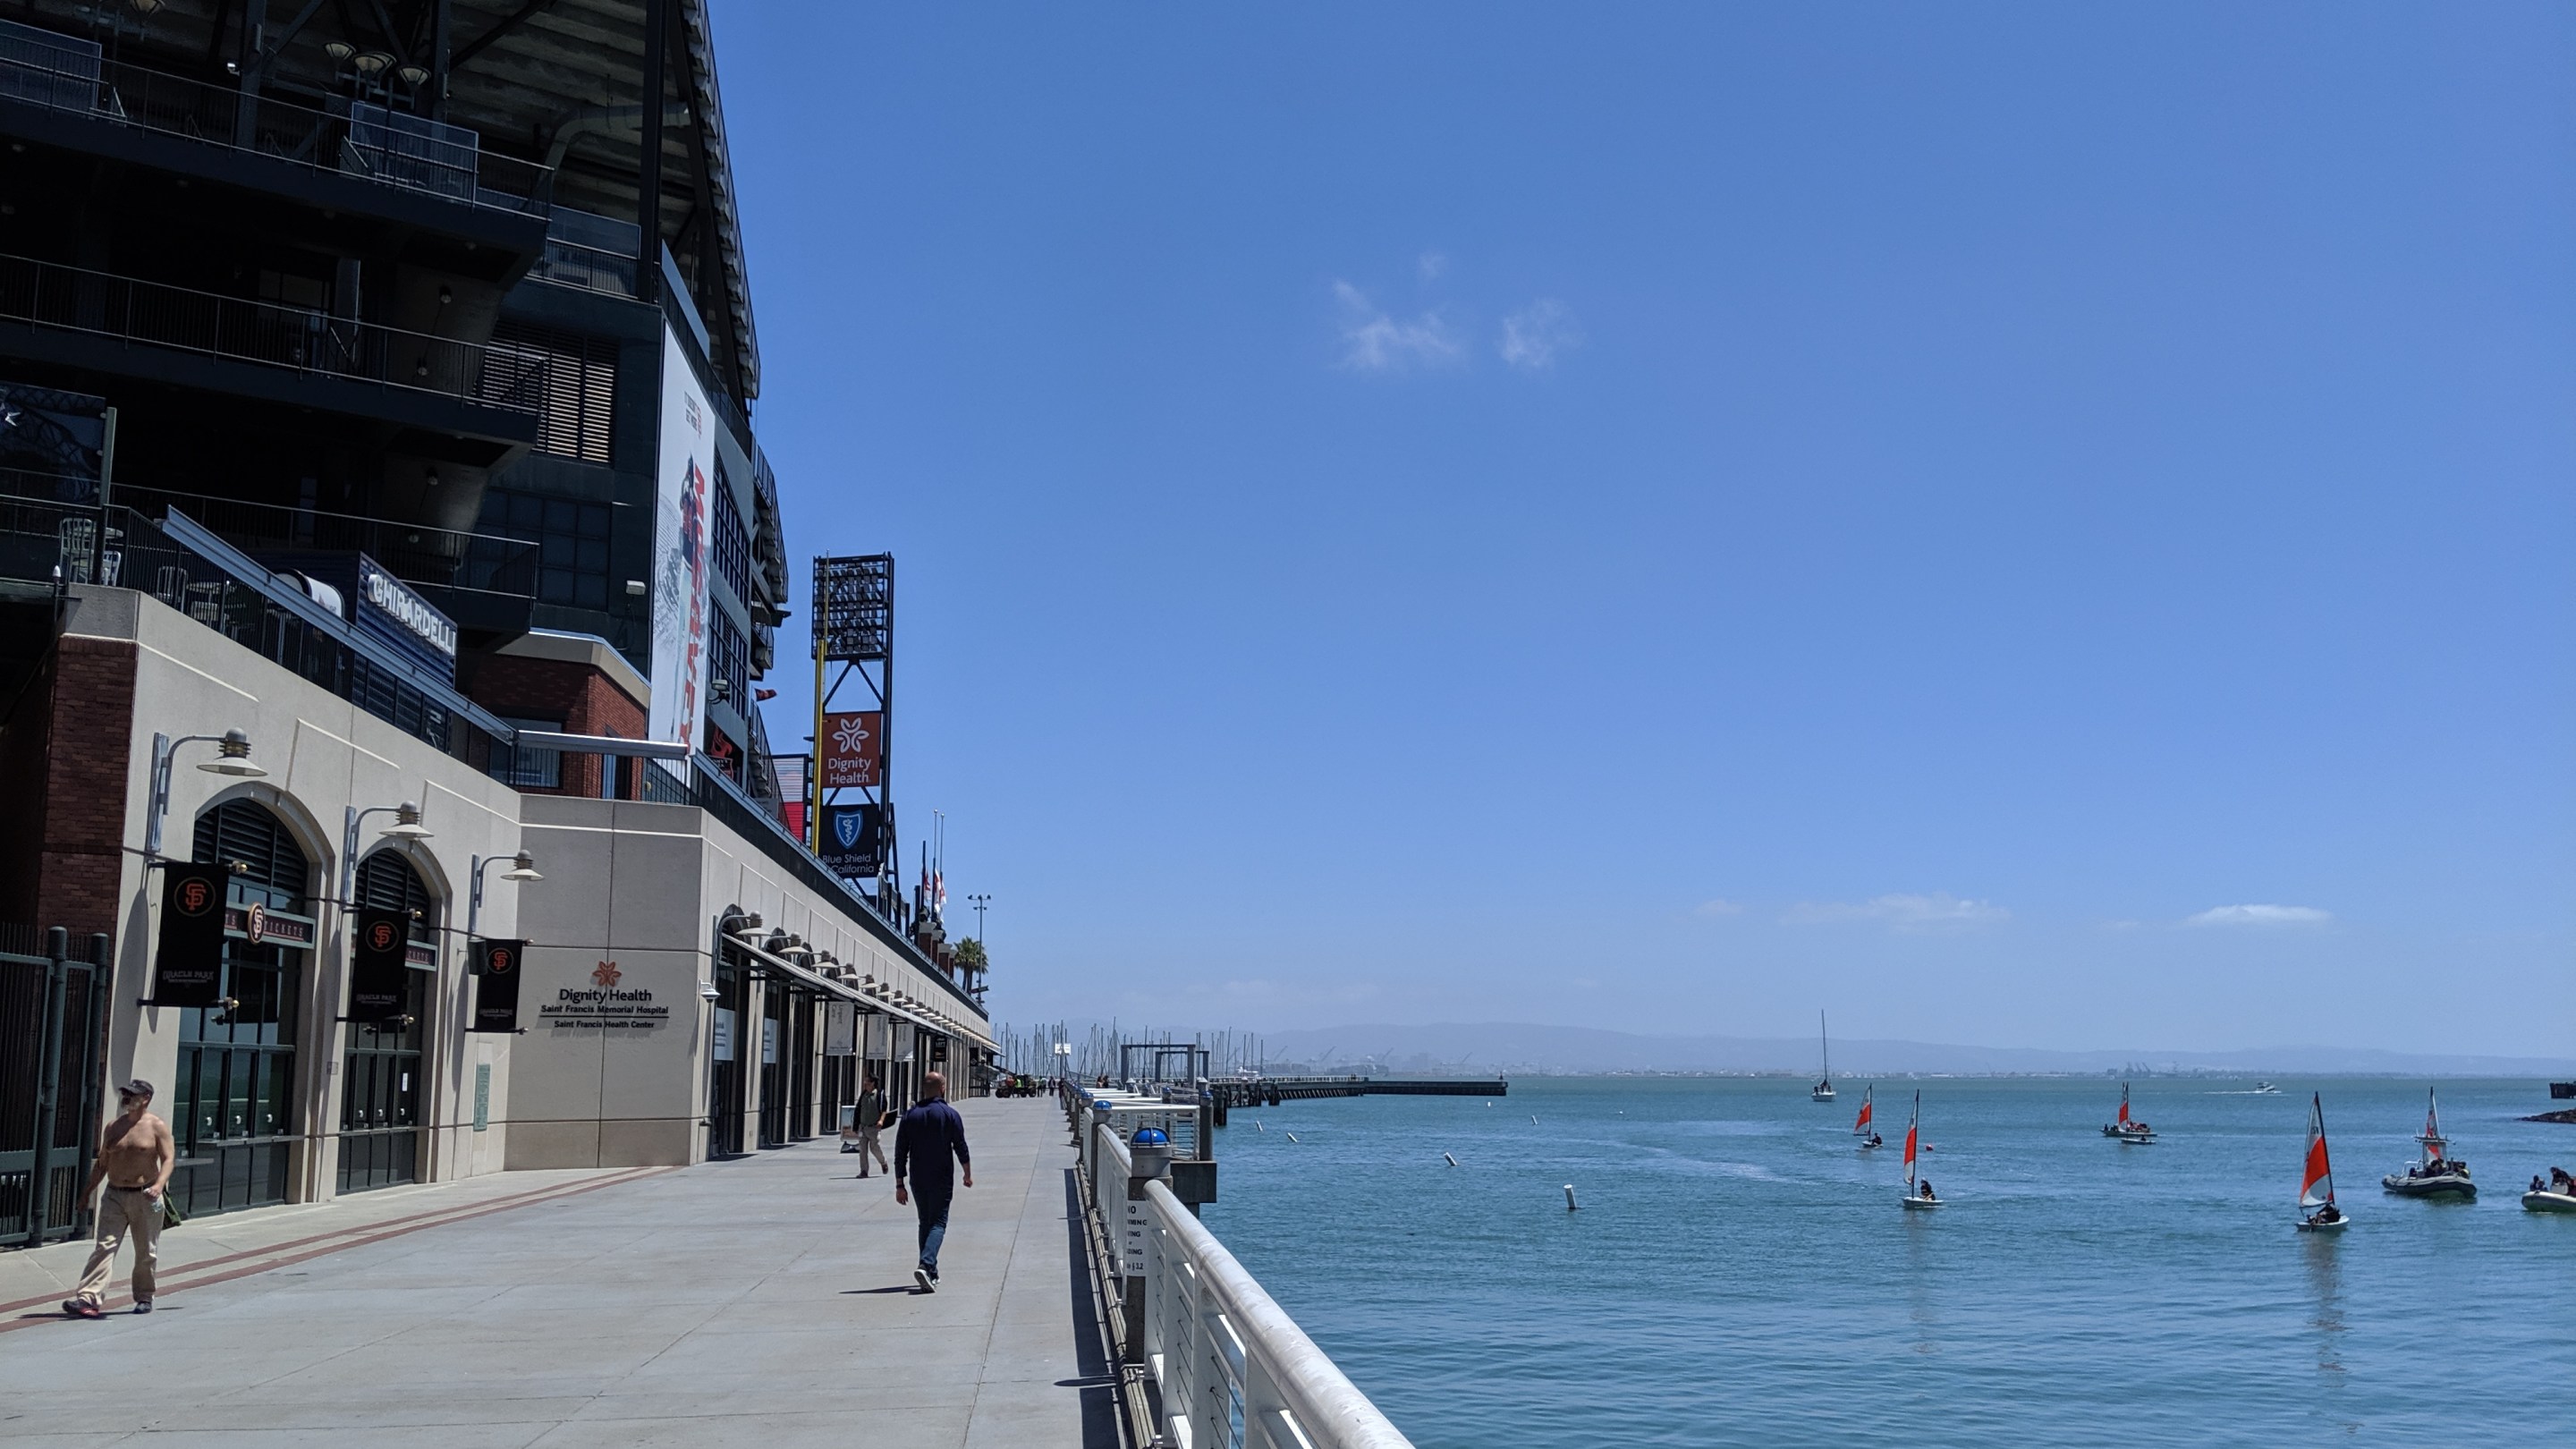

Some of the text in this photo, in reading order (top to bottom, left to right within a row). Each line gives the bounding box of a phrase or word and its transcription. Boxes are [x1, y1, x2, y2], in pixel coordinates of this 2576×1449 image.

[368, 573, 456, 657] GHIRARDELLI
[827, 757, 871, 773] Dignity
[829, 772, 869, 784] Health
[822, 852, 871, 863] Blue Shield
[831, 864, 875, 874] California
[559, 988, 652, 1004] Dignity Health
[541, 1004, 669, 1015] Saint Francis Memorial Hospital
